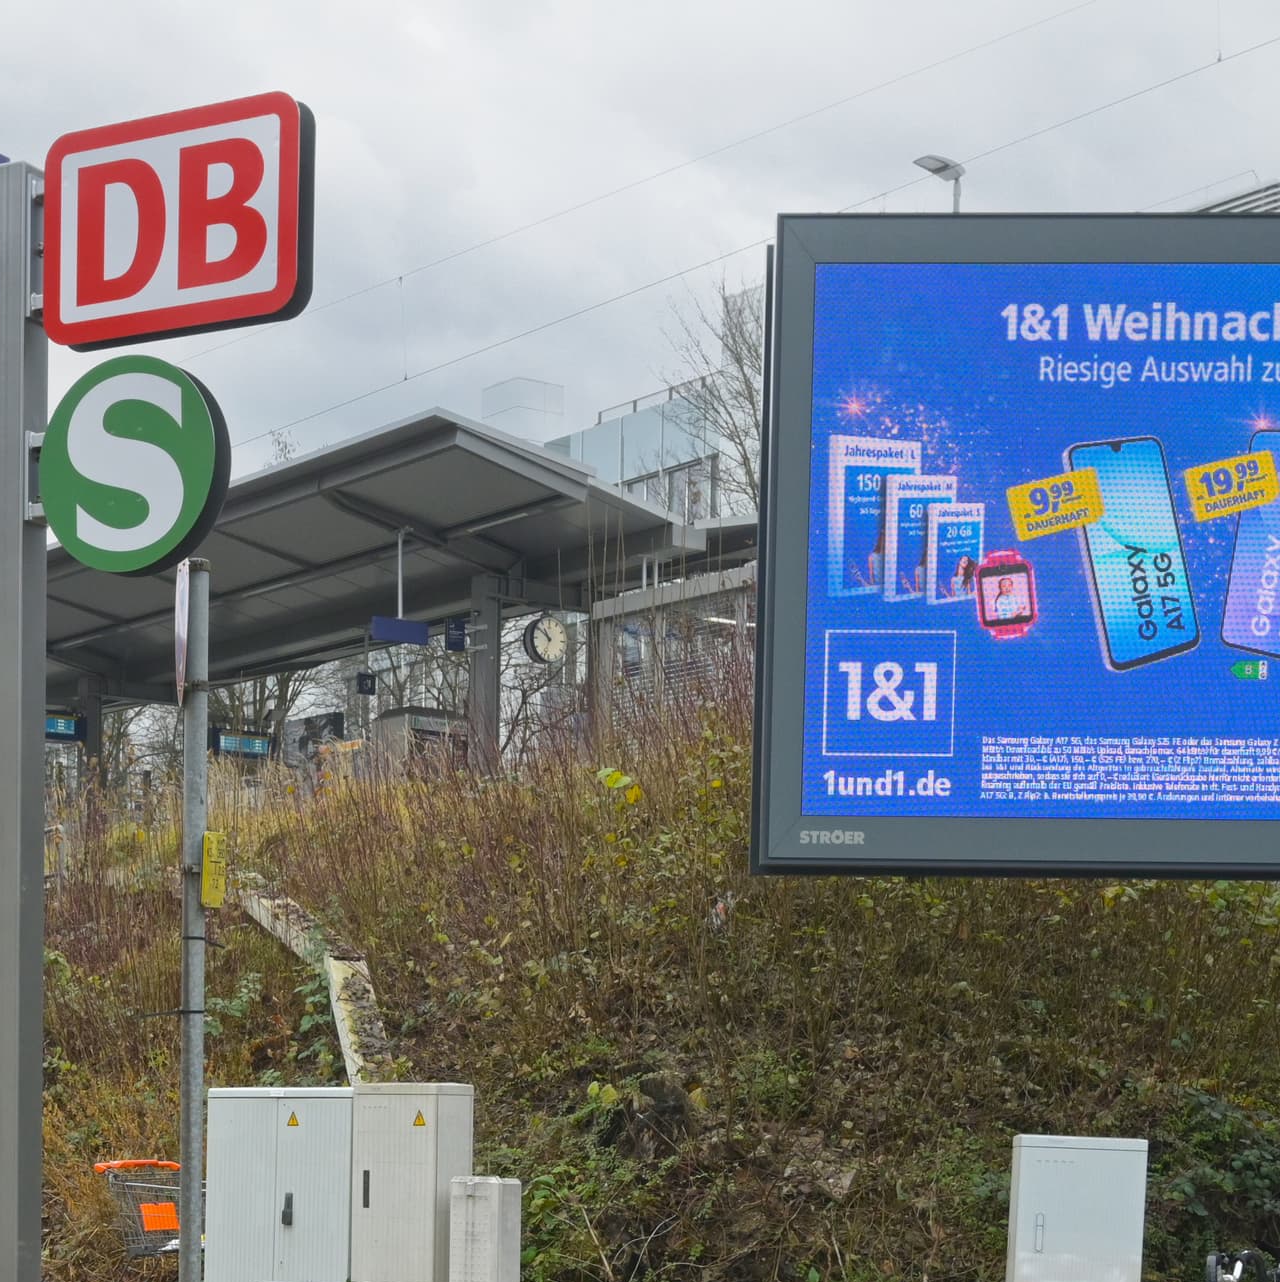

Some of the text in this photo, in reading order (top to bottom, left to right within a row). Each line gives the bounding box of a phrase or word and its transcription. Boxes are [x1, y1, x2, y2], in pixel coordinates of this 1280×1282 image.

[75, 136, 268, 307] DB
[1001, 302, 1069, 341] 1&1
[1039, 355, 1132, 386] Riesige
[1141, 354, 1252, 383] Auswahl
[66, 371, 185, 552] S
[844, 444, 904, 461] Jahrespaket
[856, 473, 882, 491] 150
[1199, 460, 1259, 498] 19,99
[909, 503, 923, 518] 60
[1029, 481, 1074, 515] 9,99
[1204, 488, 1265, 513] DAUERHAFT
[946, 526, 958, 538] 20
[1027, 507, 1089, 532] DAUERHAFT
[1124, 544, 1158, 641] Galaxy
[1154, 553, 1186, 632] A17 5G
[838, 661, 938, 722] 1&1
[823, 769, 952, 797] 1und1.de
[800, 829, 865, 845] STRÖER
